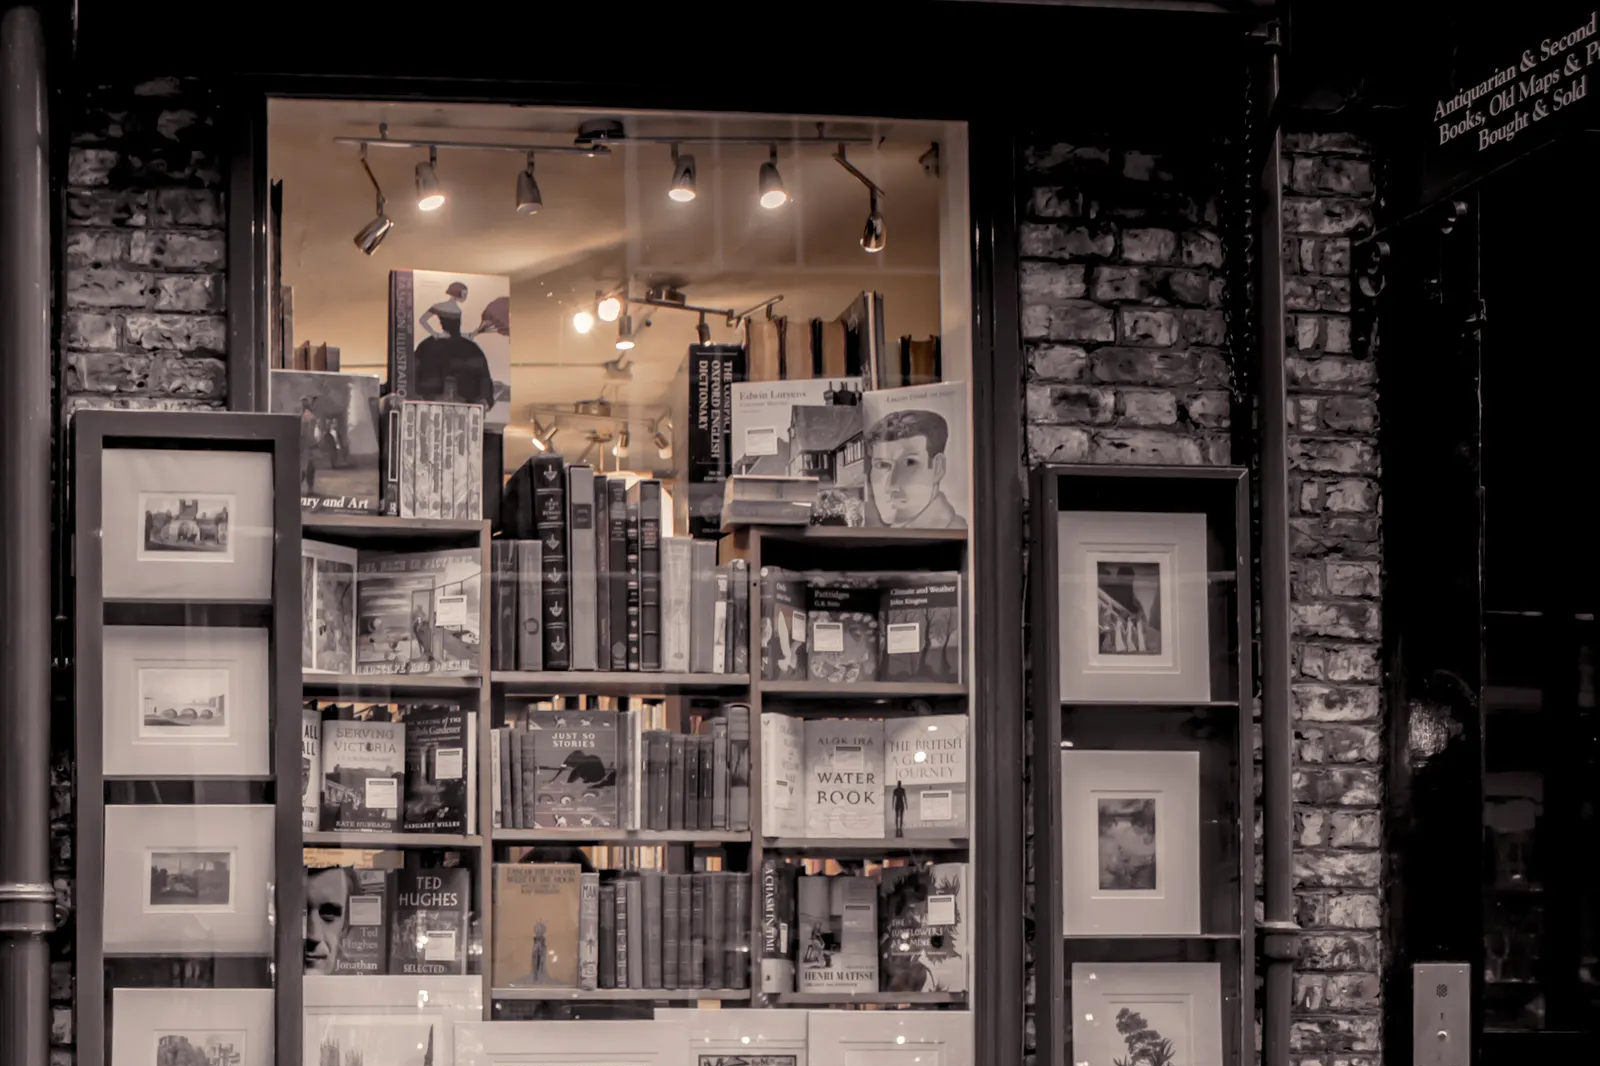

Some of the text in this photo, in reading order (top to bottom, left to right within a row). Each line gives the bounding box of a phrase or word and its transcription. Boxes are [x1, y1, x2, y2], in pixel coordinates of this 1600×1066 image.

[1433, 11, 1597, 122] Antiquarian & Second
[1439, 111, 1486, 145] Books,
[1489, 86, 1515, 117] Old
[1519, 68, 1560, 103] Maps
[1563, 54, 1582, 76] &
[1478, 75, 1588, 151] Bought & Sold
[396, 333, 407, 398] ILLUSTRATIO
[723, 360, 733, 382] THE
[698, 360, 709, 431] DICTIONARY
[739, 390, 768, 401] Edwin
[710, 360, 721, 458] OXFORD ENGLISH
[301, 496, 369, 509] nry and Art
[814, 590, 850, 600] Partridges
[890, 584, 956, 596] Climate and Weather
[357, 663, 406, 675] ANDSCAPE
[450, 716, 462, 724] THE
[336, 728, 395, 740] SERVING
[429, 726, 461, 736] Gardener
[552, 732, 596, 740] JUST SO
[334, 741, 397, 754] VICTORIA
[552, 740, 596, 748] STORIES
[816, 737, 849, 746] ALOK
[889, 739, 962, 752] THE BRITISH
[817, 772, 876, 785] WATER
[895, 766, 955, 780] JOURNEY
[816, 791, 876, 805] BOOK
[416, 876, 442, 890] TED
[399, 892, 458, 907] HUGHES
[764, 875, 775, 912] CHASM
[764, 914, 775, 926] IN
[360, 927, 378, 938] Ted
[892, 927, 944, 938] SUFLOWERS
[342, 938, 378, 950] Hughes
[764, 927, 775, 953] TIME
[335, 959, 378, 971] Jonathan
[403, 964, 445, 974] SELECTED
[804, 971, 874, 981] HENRI MATISSE
